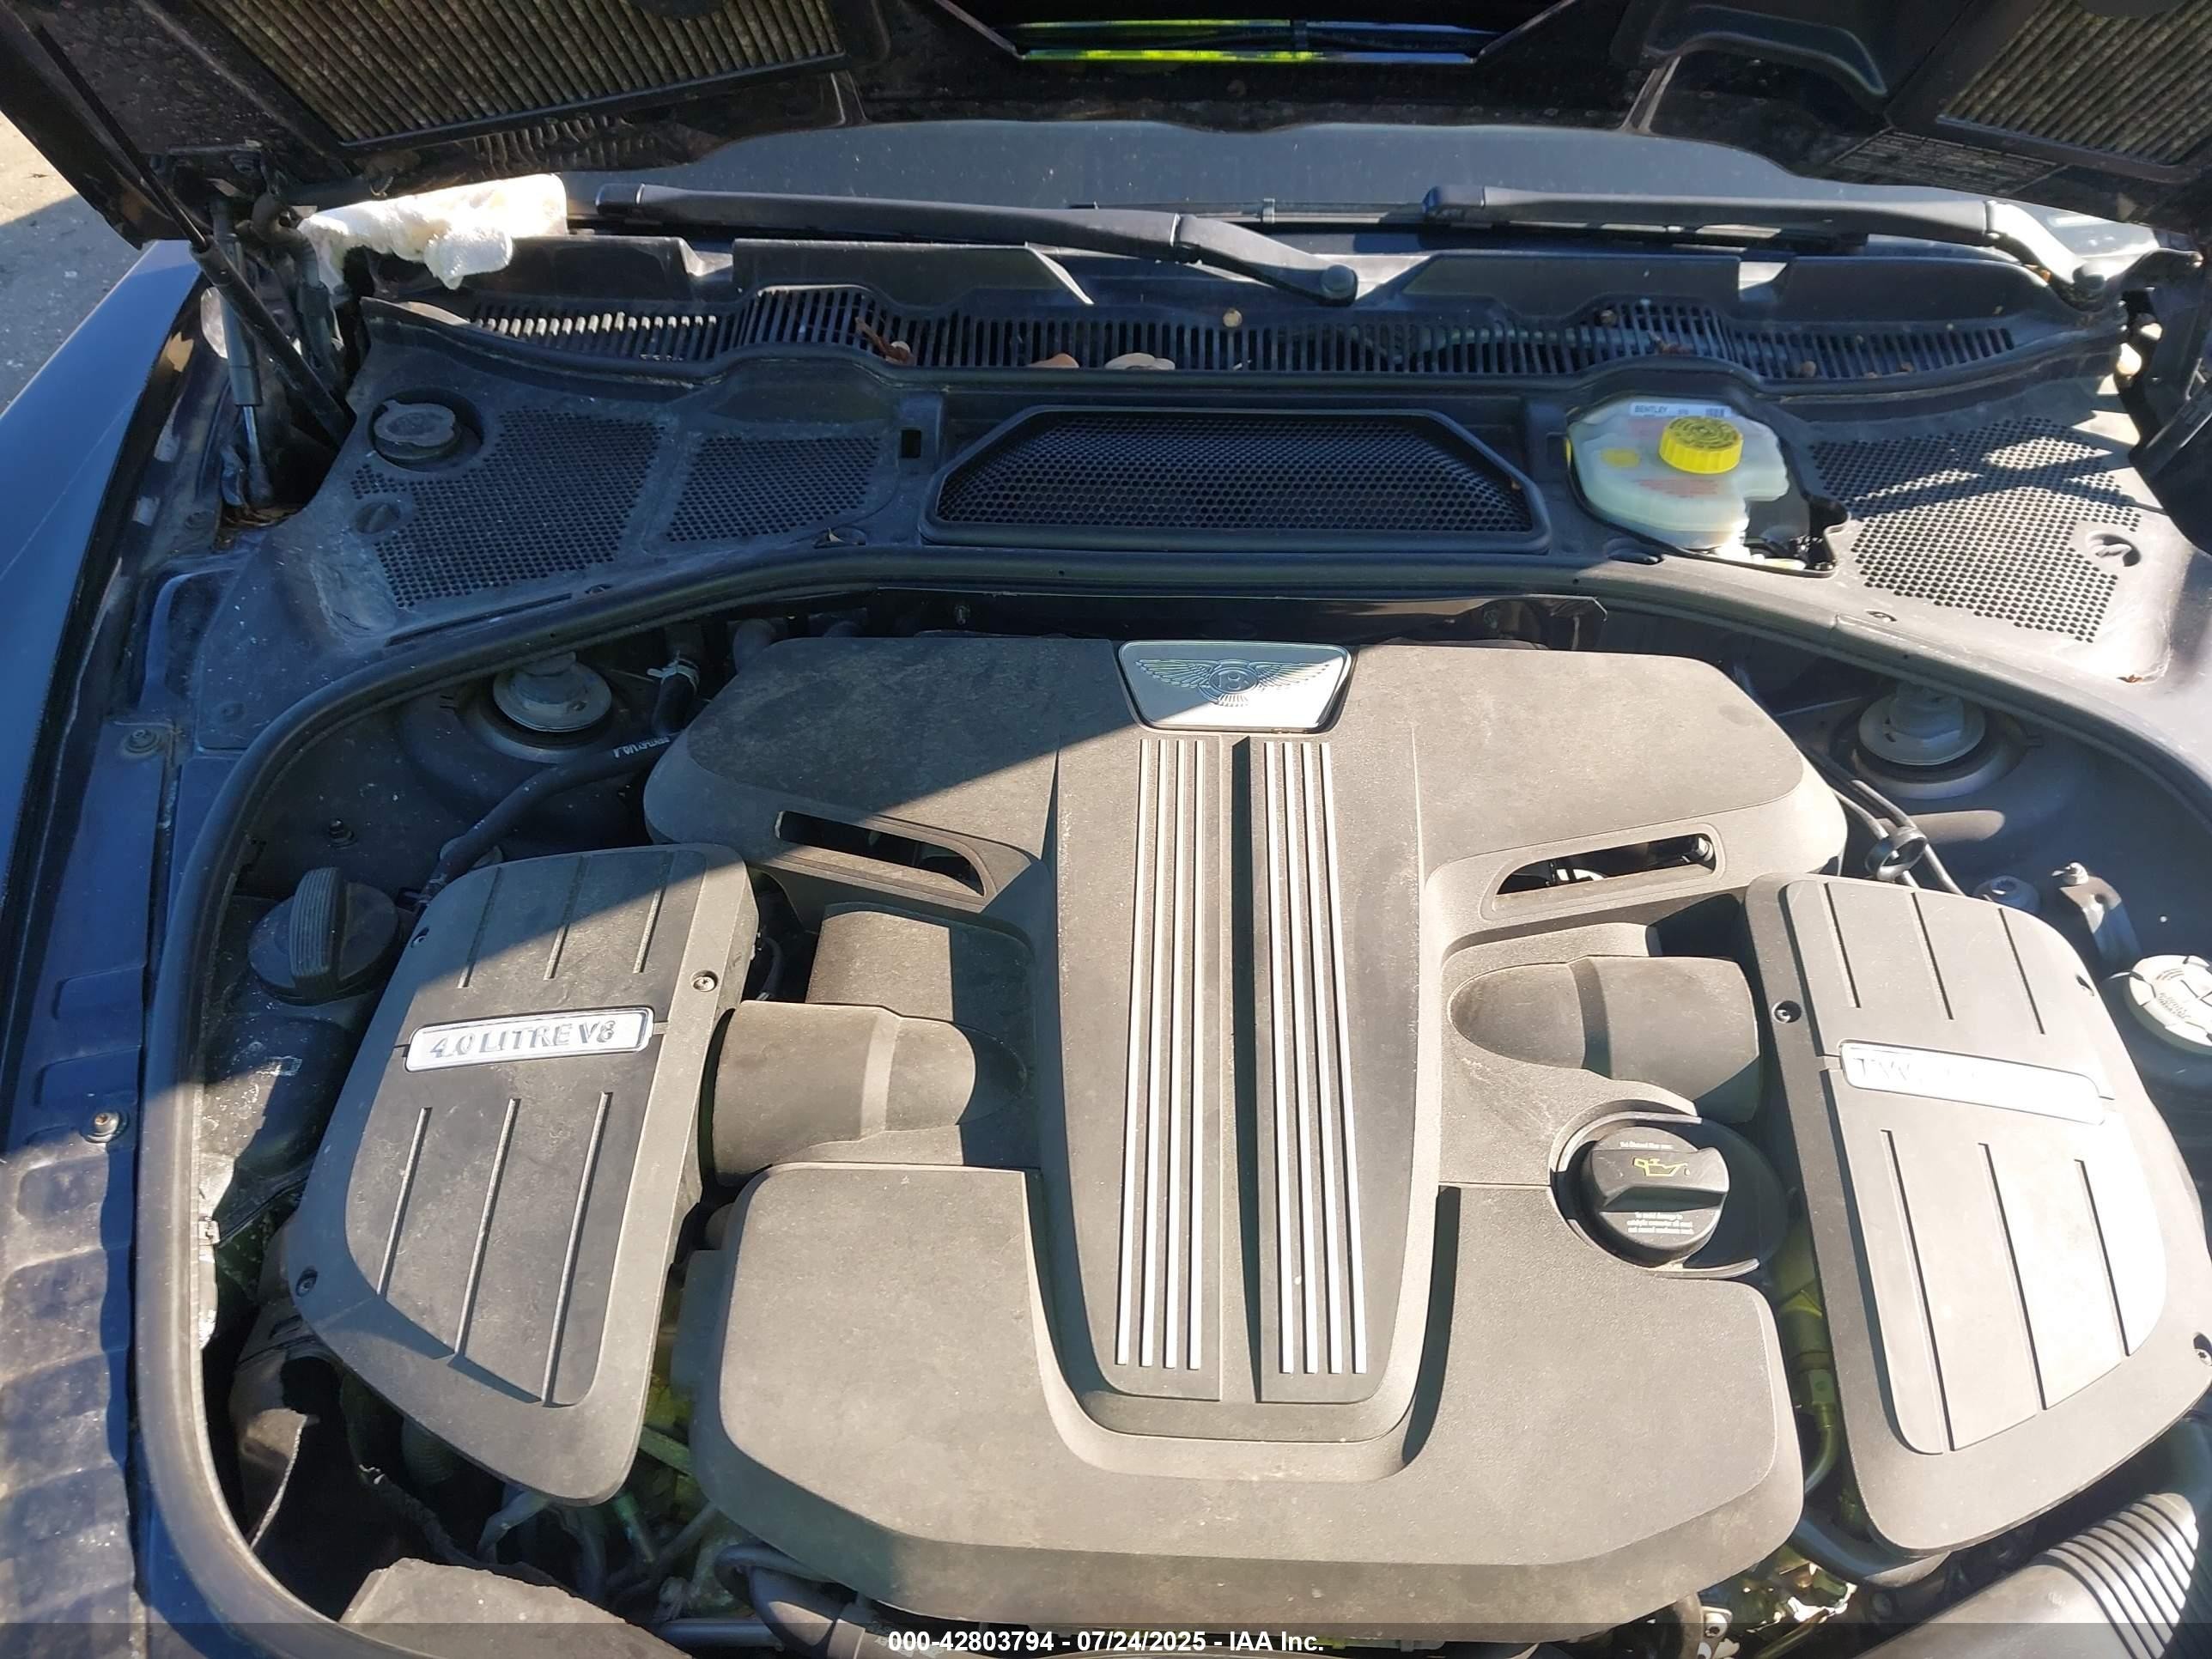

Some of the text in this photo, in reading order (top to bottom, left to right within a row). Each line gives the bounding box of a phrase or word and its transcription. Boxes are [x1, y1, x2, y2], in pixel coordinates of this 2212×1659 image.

[1634, 404, 1668, 413] BENTLEY
[429, 1019, 617, 1059] 4.0 LITRE V8
